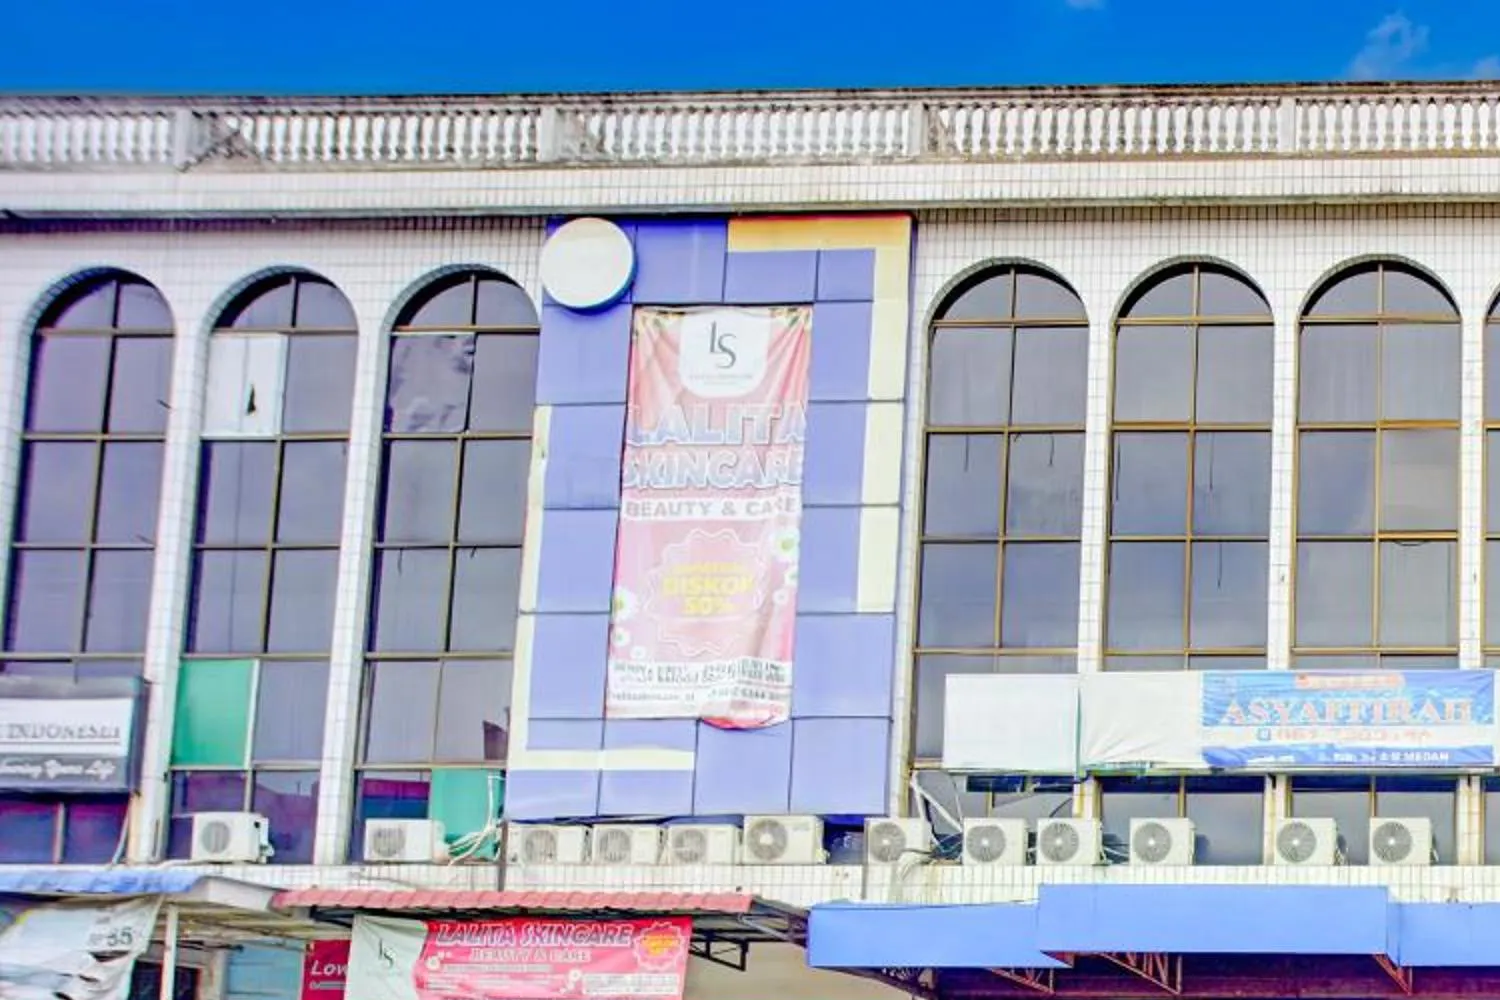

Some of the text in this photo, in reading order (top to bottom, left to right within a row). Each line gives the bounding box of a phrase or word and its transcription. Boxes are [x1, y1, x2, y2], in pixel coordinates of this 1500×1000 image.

[627, 402, 806, 446] LALITA
[624, 450, 803, 489] SKINCARE
[626, 501, 712, 517] BEAUTY
[721, 501, 736, 516] &
[436, 923, 516, 947] LALITA
[520, 923, 635, 947] SKINCARE
